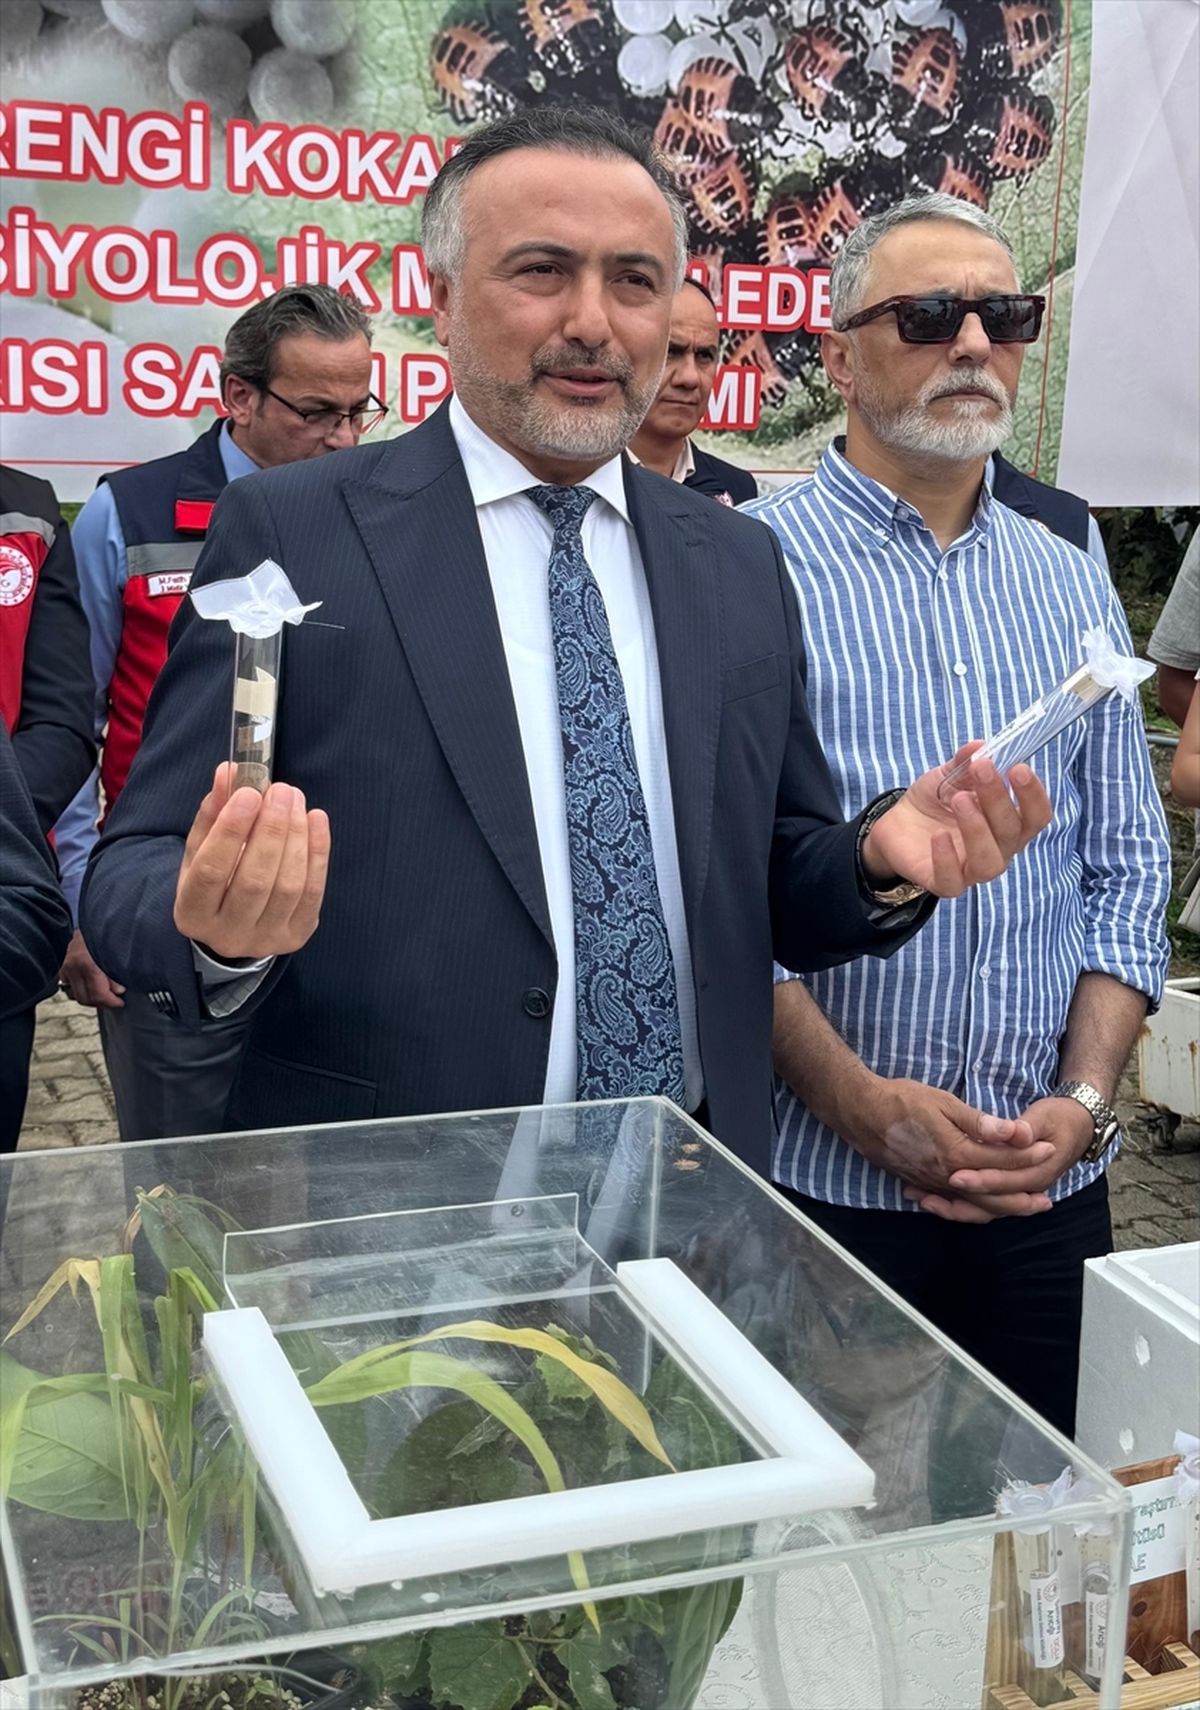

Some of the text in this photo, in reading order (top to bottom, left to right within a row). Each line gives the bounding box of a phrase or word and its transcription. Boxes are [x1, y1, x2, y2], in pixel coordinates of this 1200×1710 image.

[233, 125, 462, 199] KOKA
[0, 212, 376, 308] İYOLOJİK
[0, 344, 102, 409] ISI
